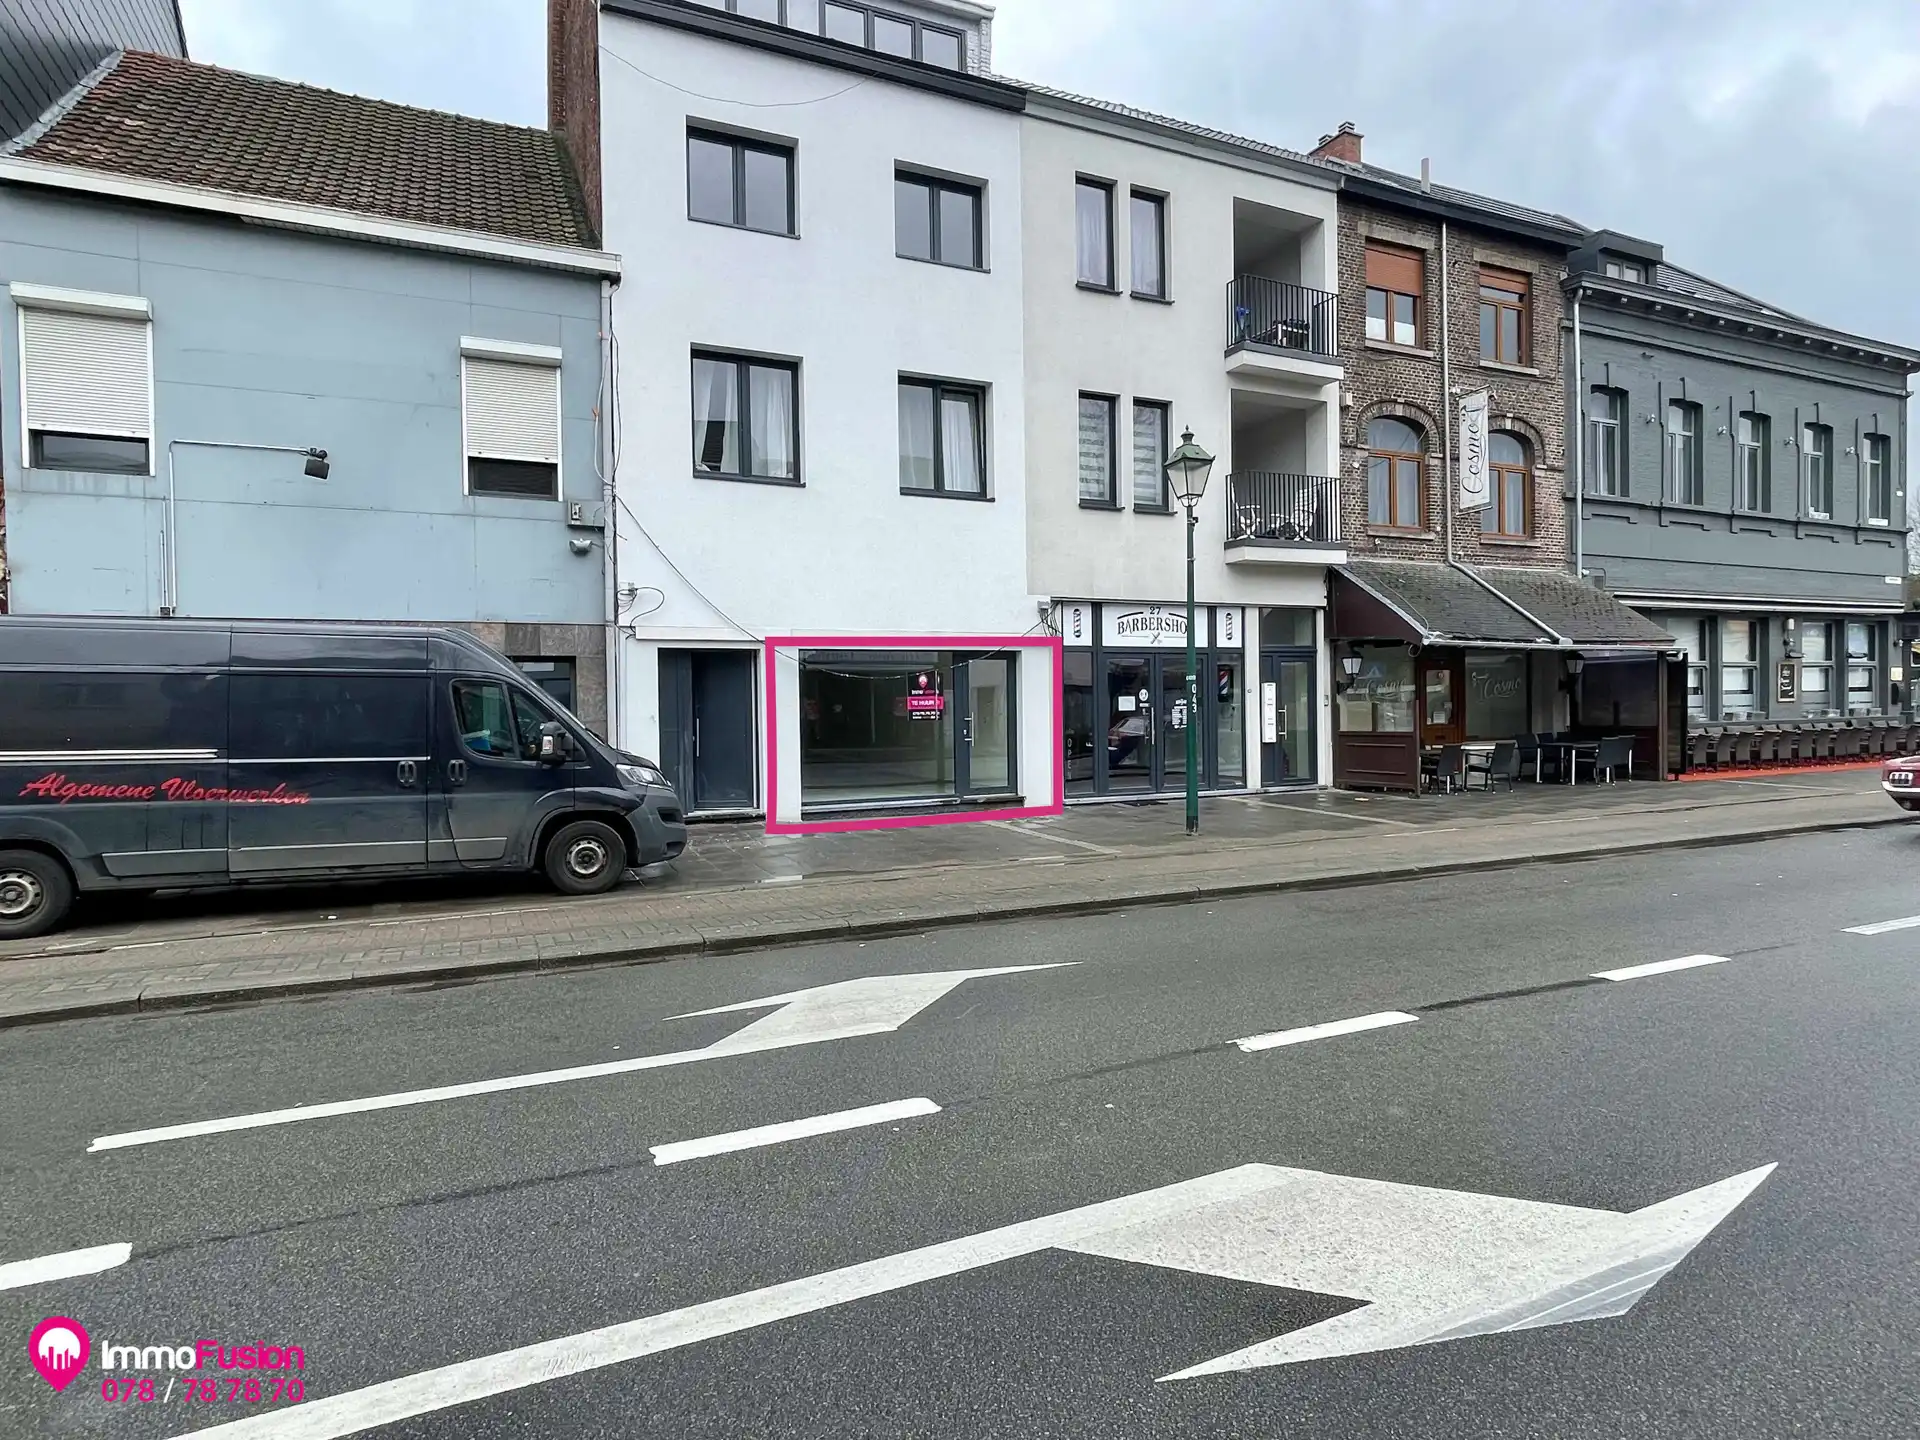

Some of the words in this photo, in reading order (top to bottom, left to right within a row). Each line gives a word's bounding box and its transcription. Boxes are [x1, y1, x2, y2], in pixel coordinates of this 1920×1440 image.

[1461, 422, 1486, 494] Cosmo
[1149, 605, 1162, 615] 27
[1117, 616, 1188, 635] BARBERSHO
[1484, 676, 1522, 698] Cosmo
[18, 771, 156, 805] Algemene
[160, 776, 311, 805] Vloerwerken
